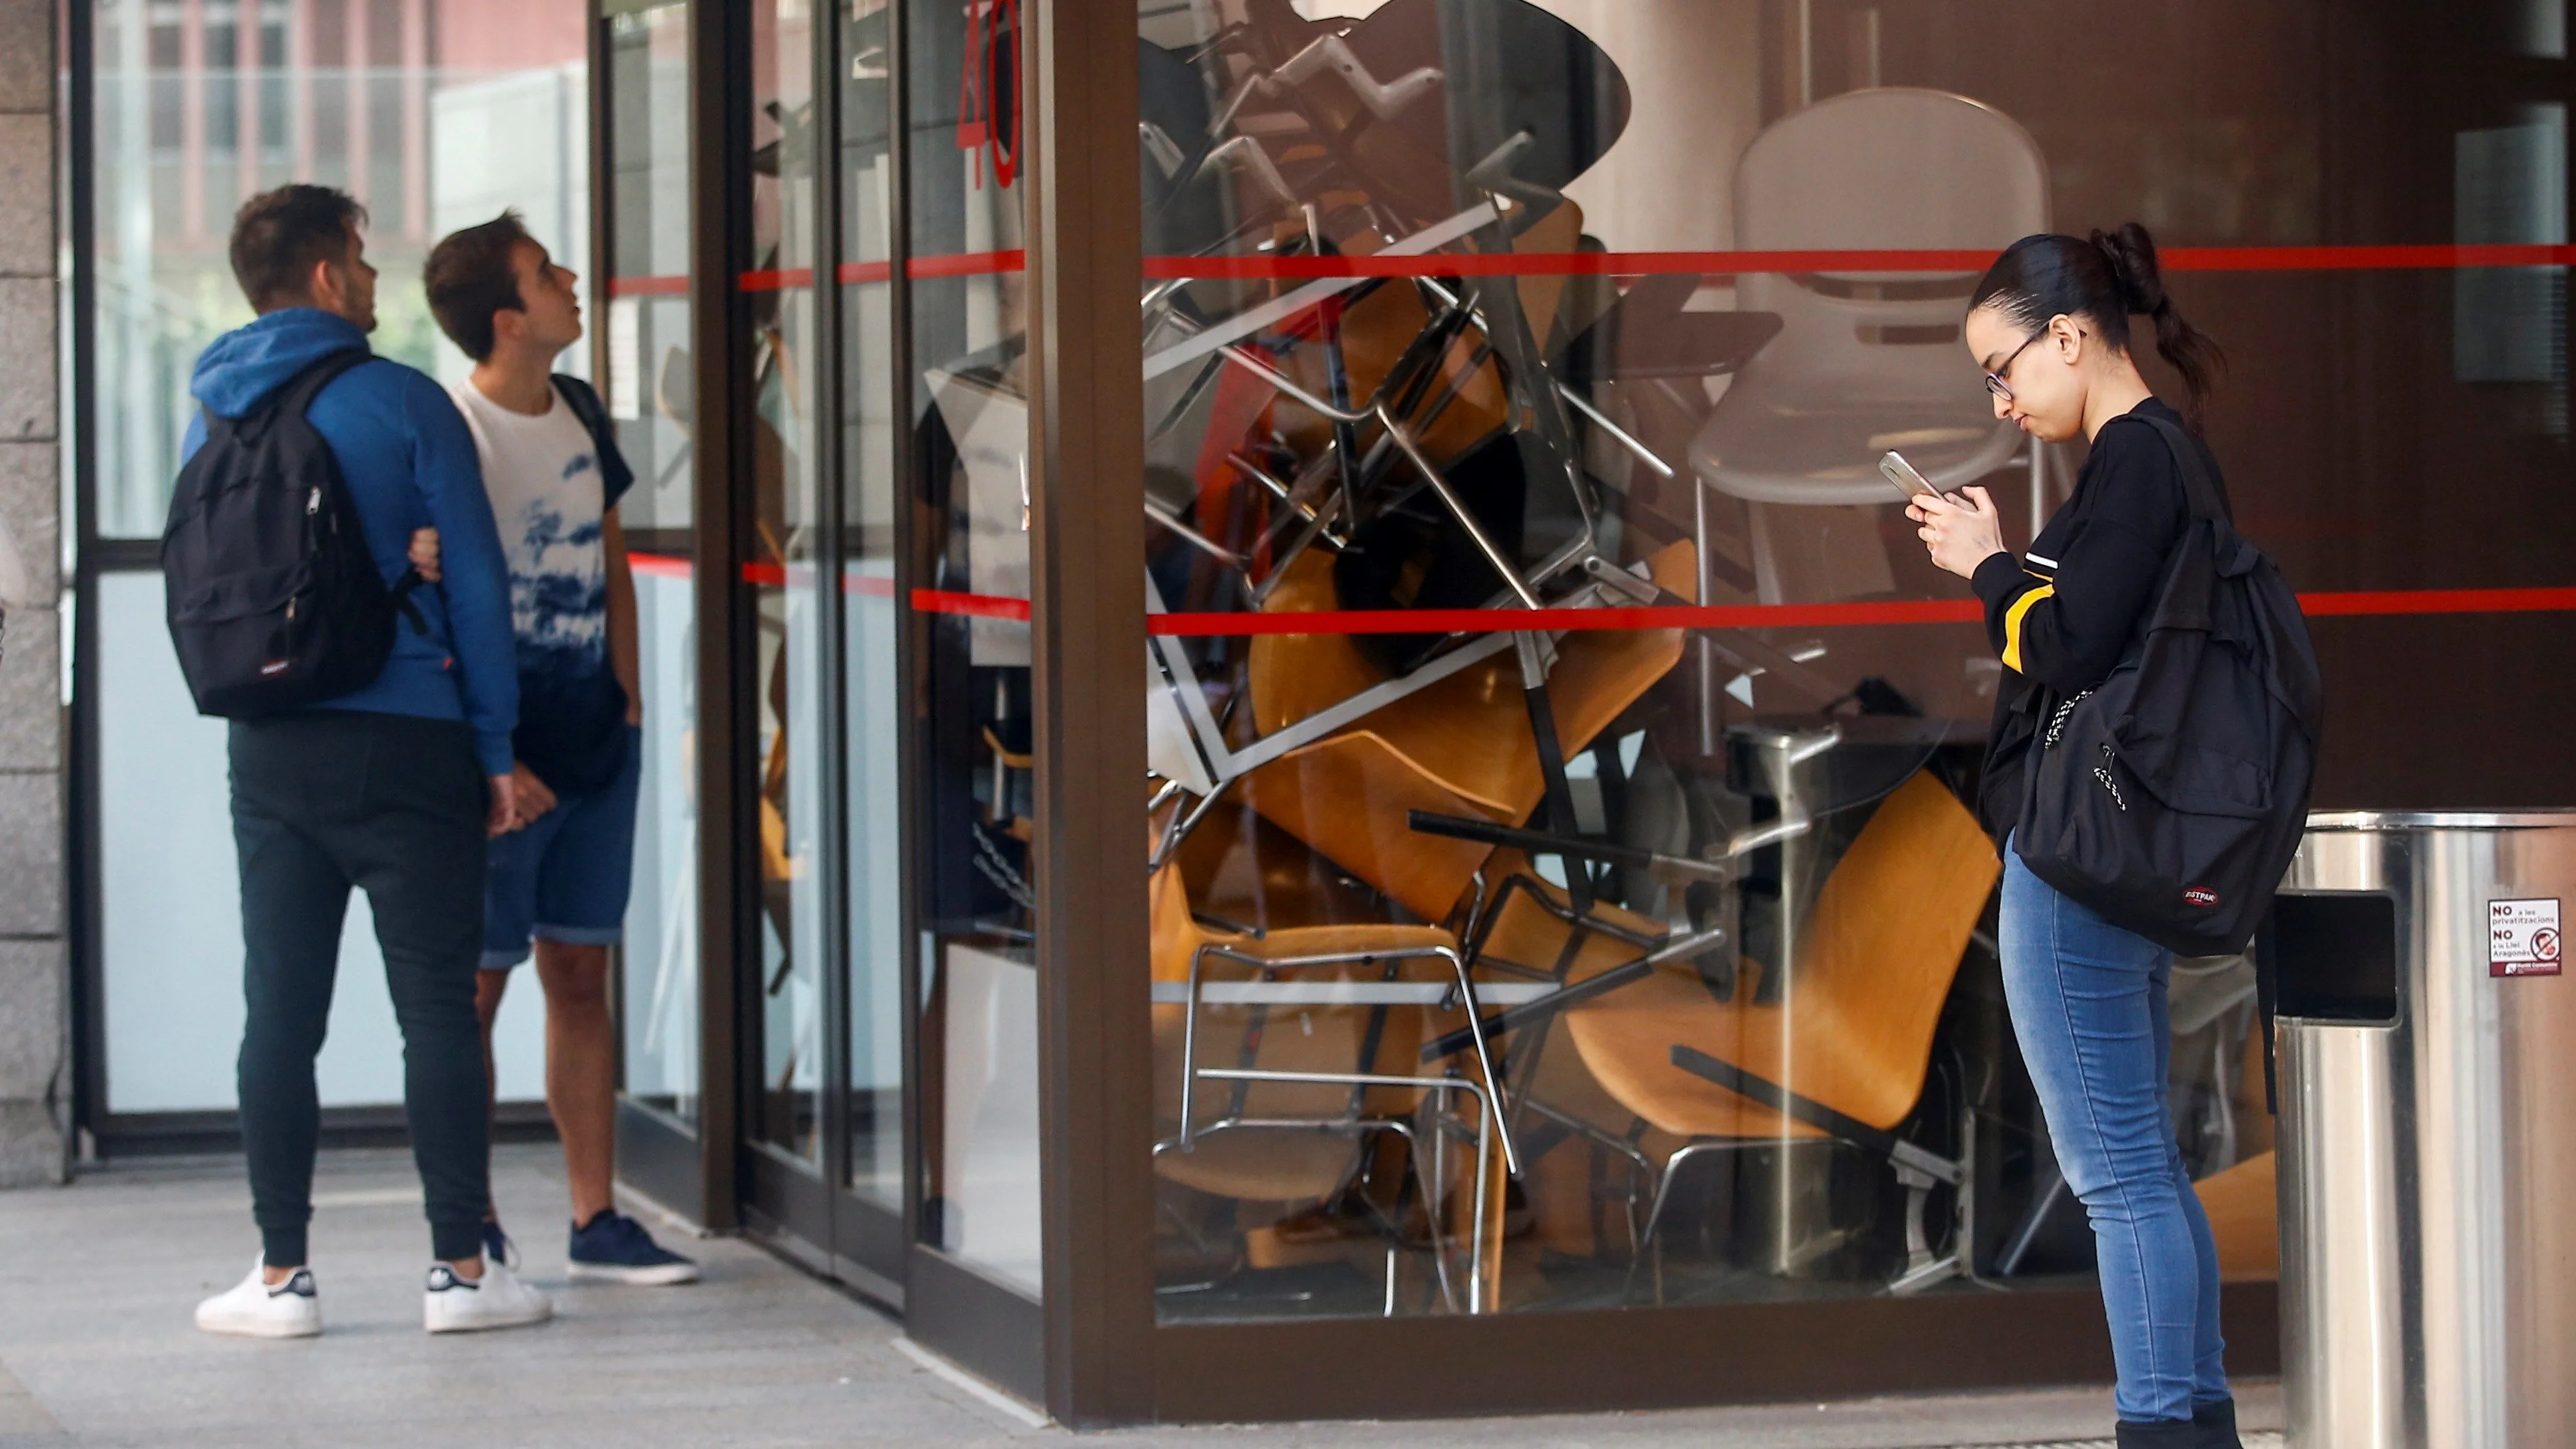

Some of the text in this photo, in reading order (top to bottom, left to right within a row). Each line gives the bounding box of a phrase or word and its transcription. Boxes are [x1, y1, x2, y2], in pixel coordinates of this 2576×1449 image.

[956, 0, 1021, 191] 40
[2492, 906, 2513, 916] NO
[2493, 930, 2513, 940] NO
